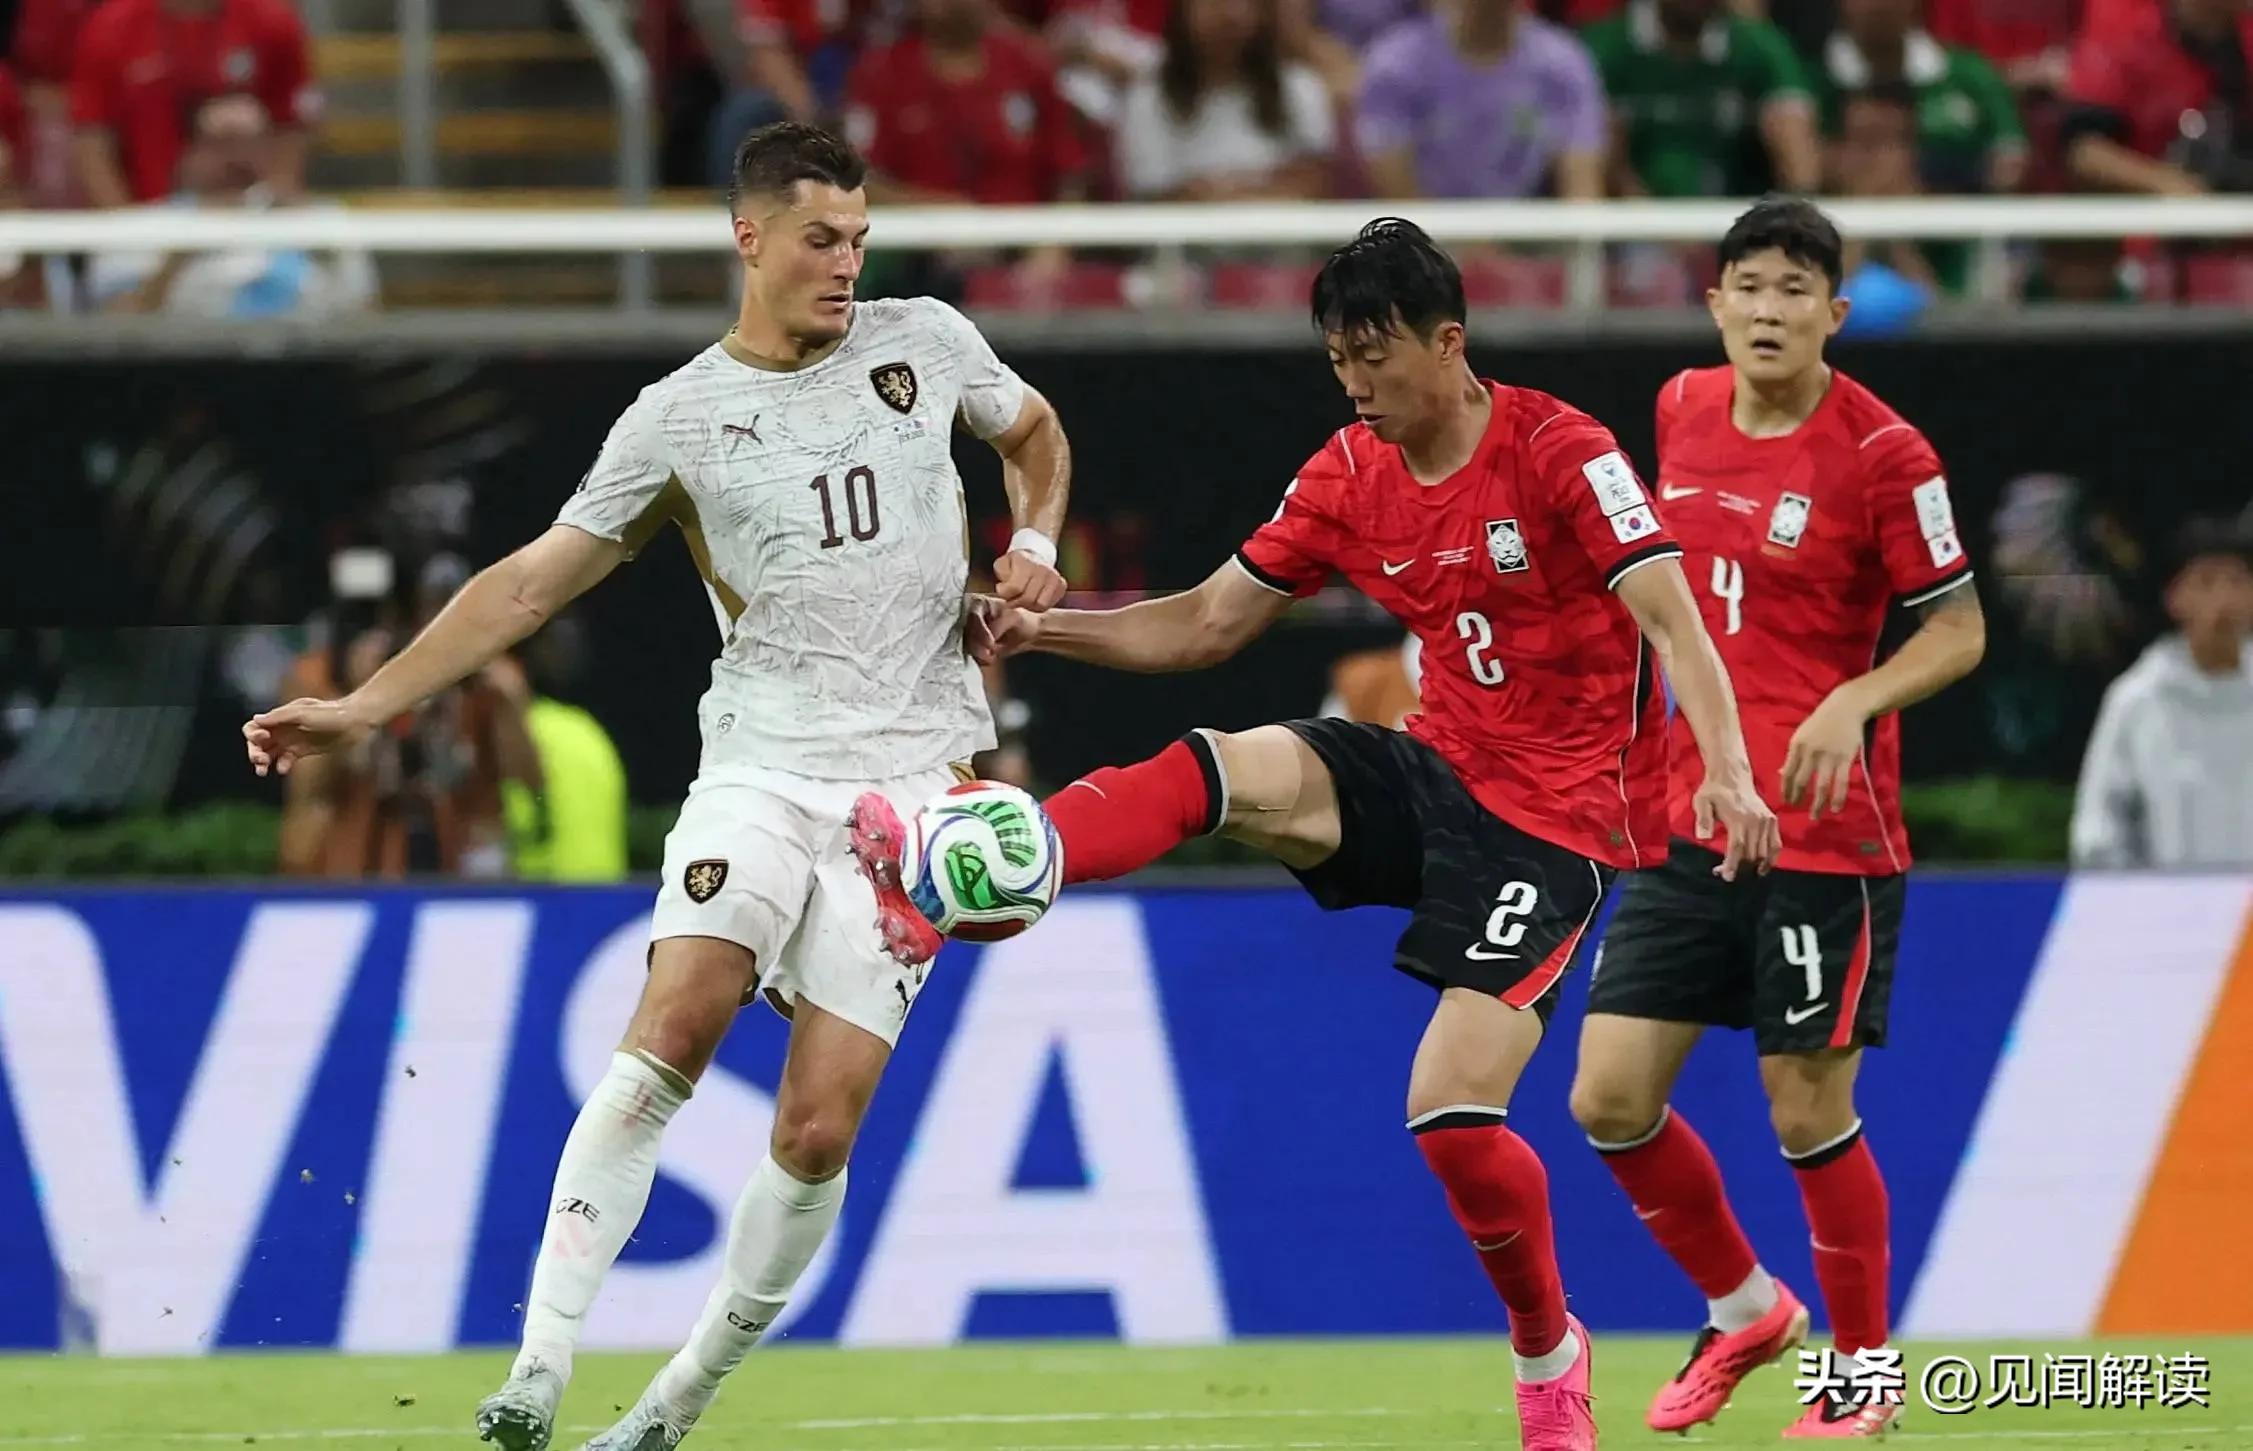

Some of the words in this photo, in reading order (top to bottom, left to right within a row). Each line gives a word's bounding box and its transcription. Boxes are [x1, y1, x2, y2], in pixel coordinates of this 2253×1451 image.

[809, 464, 881, 549] 10
[1710, 555, 1744, 635] 4
[1455, 610, 1505, 686] 2
[1485, 880, 1538, 946] 2
[1779, 923, 1823, 1001] 4
[0, 898, 1231, 1358] VISA
[555, 1196, 601, 1224] CZE
[726, 1310, 767, 1334] CZE
